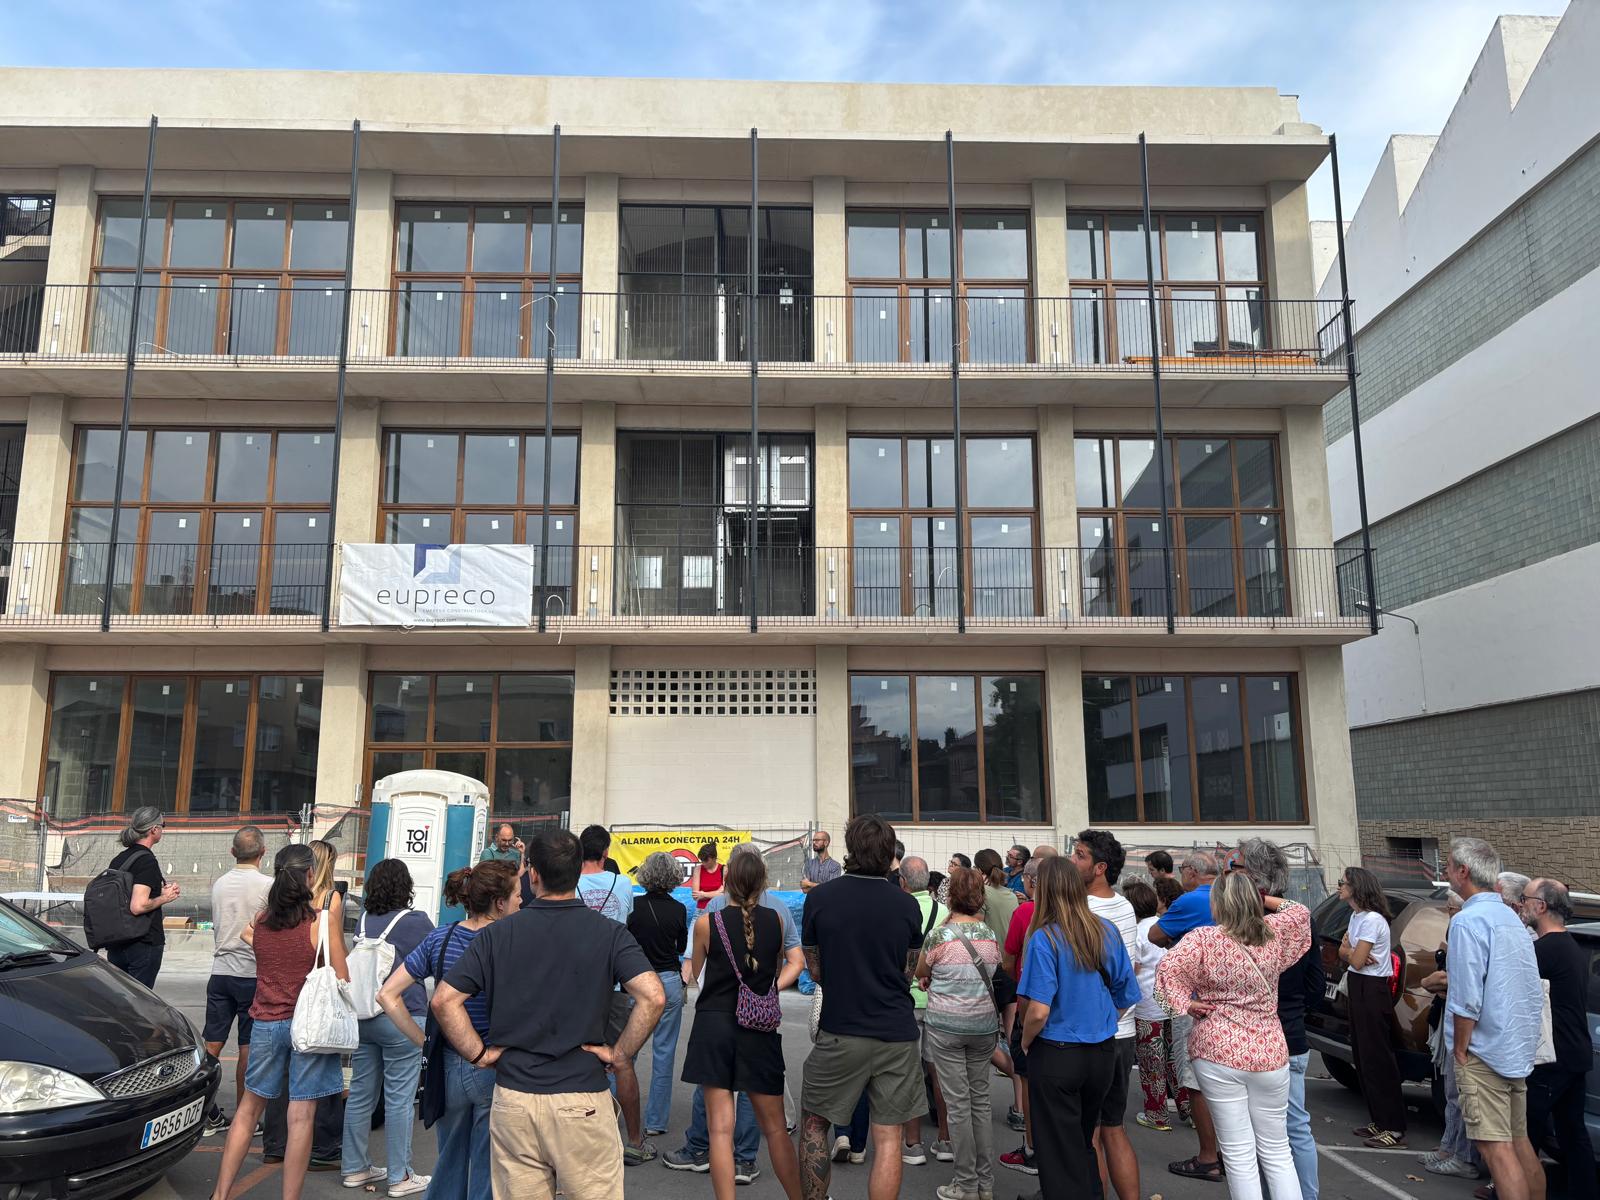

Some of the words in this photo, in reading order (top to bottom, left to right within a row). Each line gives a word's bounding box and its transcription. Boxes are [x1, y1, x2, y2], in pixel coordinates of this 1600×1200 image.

[376, 588, 496, 613] eupreco
[407, 828, 429, 841] TOI
[621, 837, 660, 845] ALARMA
[663, 836, 720, 844] CONECTADA
[722, 835, 740, 844] 24H
[406, 841, 428, 853] TOI
[152, 1112, 182, 1141] 9656
[183, 1100, 203, 1128] DZF
